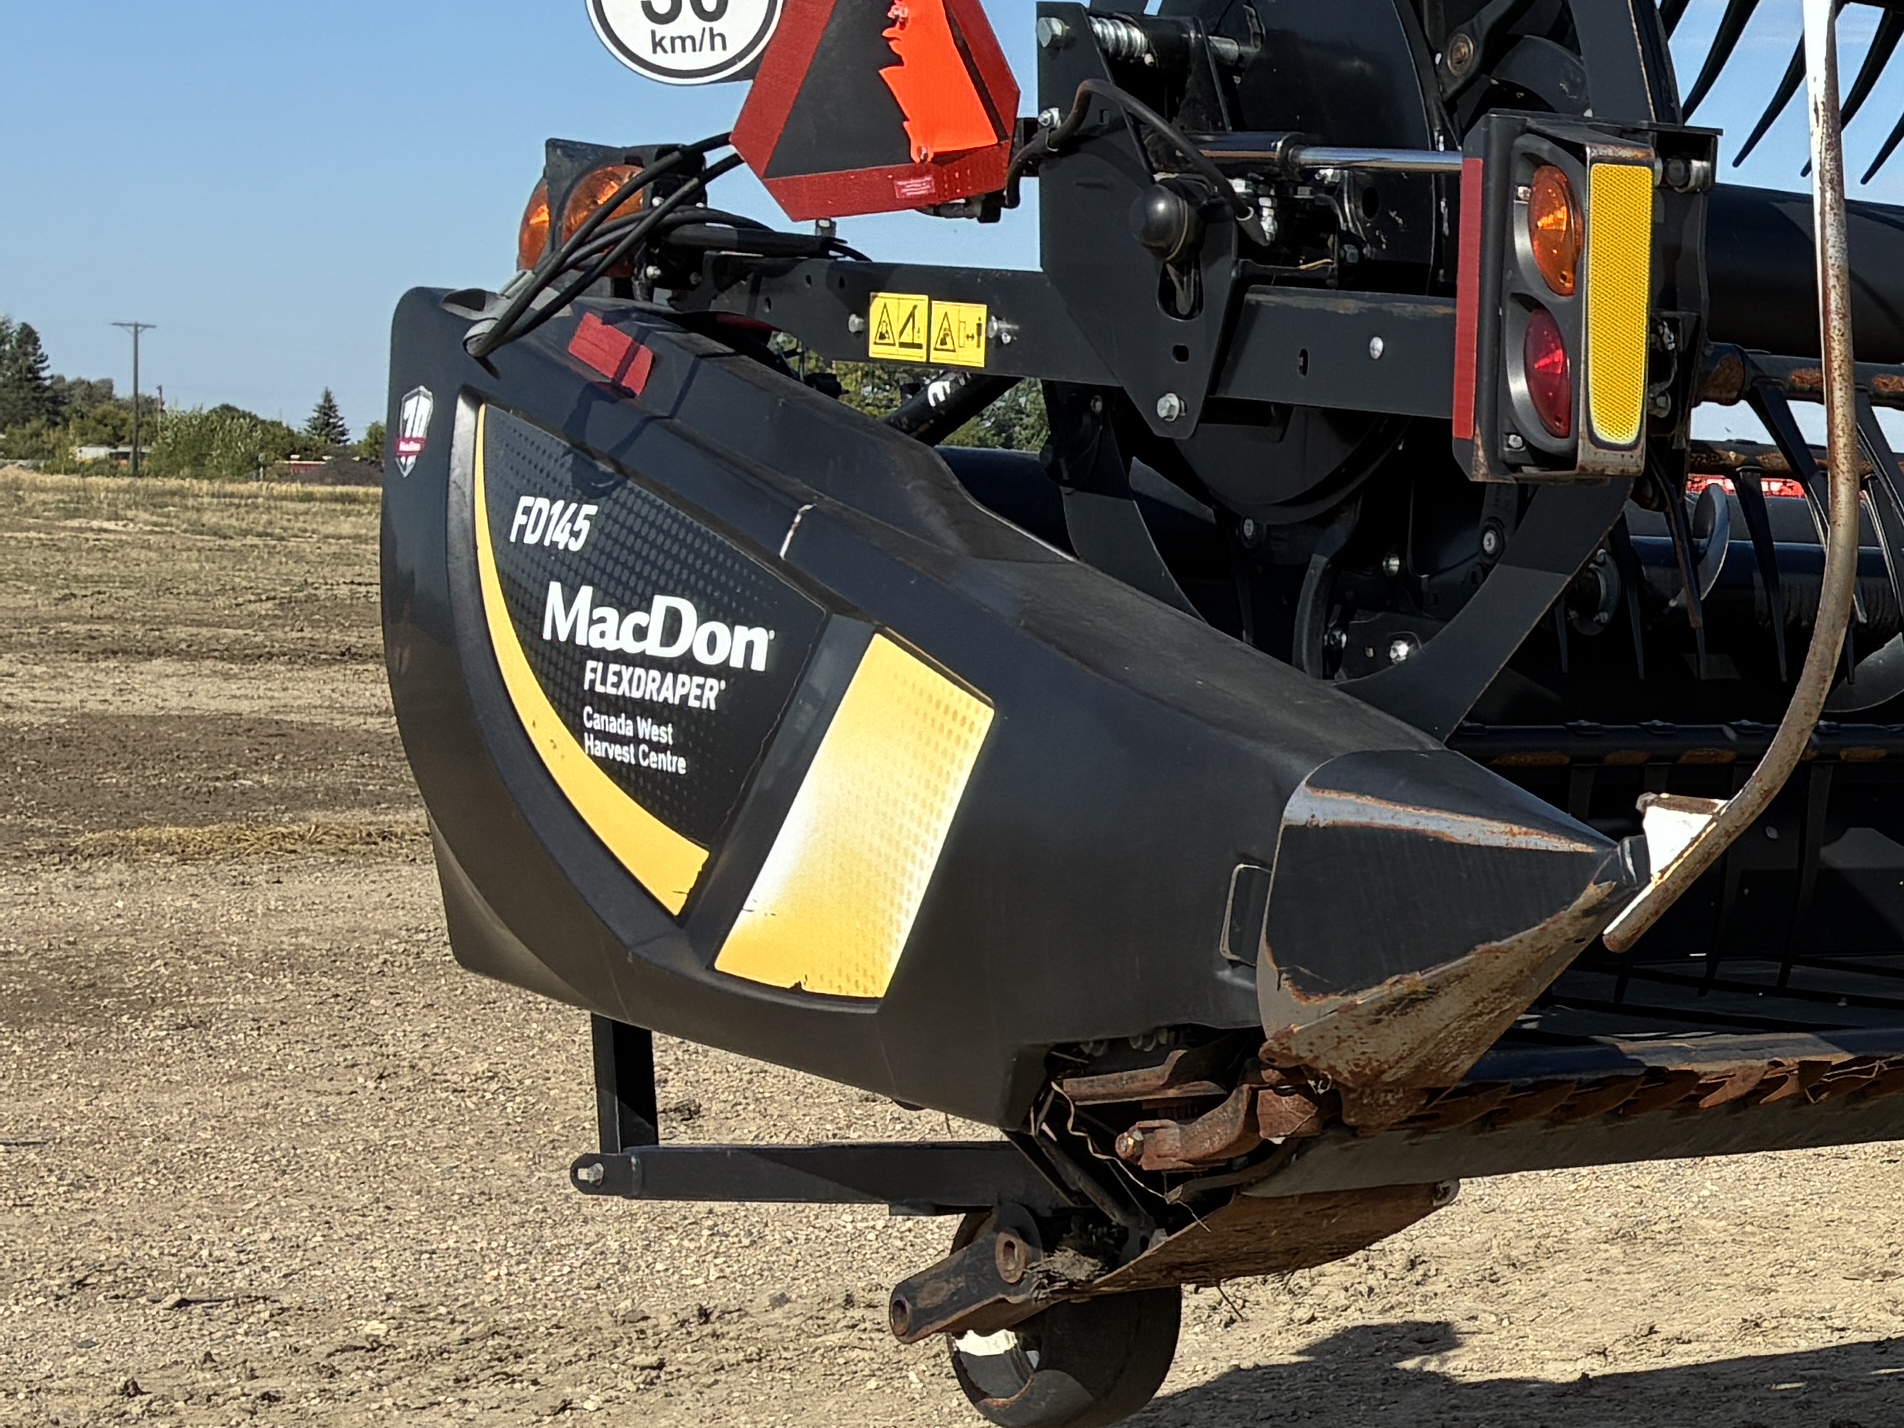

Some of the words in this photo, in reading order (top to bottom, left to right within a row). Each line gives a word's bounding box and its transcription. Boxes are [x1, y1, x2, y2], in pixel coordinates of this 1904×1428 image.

[650, 26, 727, 55] km/h
[509, 495, 598, 552] FD145
[542, 580, 769, 672] MacDon
[583, 659, 720, 711] FLEXDRAPER
[582, 705, 633, 738] Canada
[636, 716, 674, 745] West
[583, 732, 636, 765] Harvest
[638, 744, 687, 775] Centre
